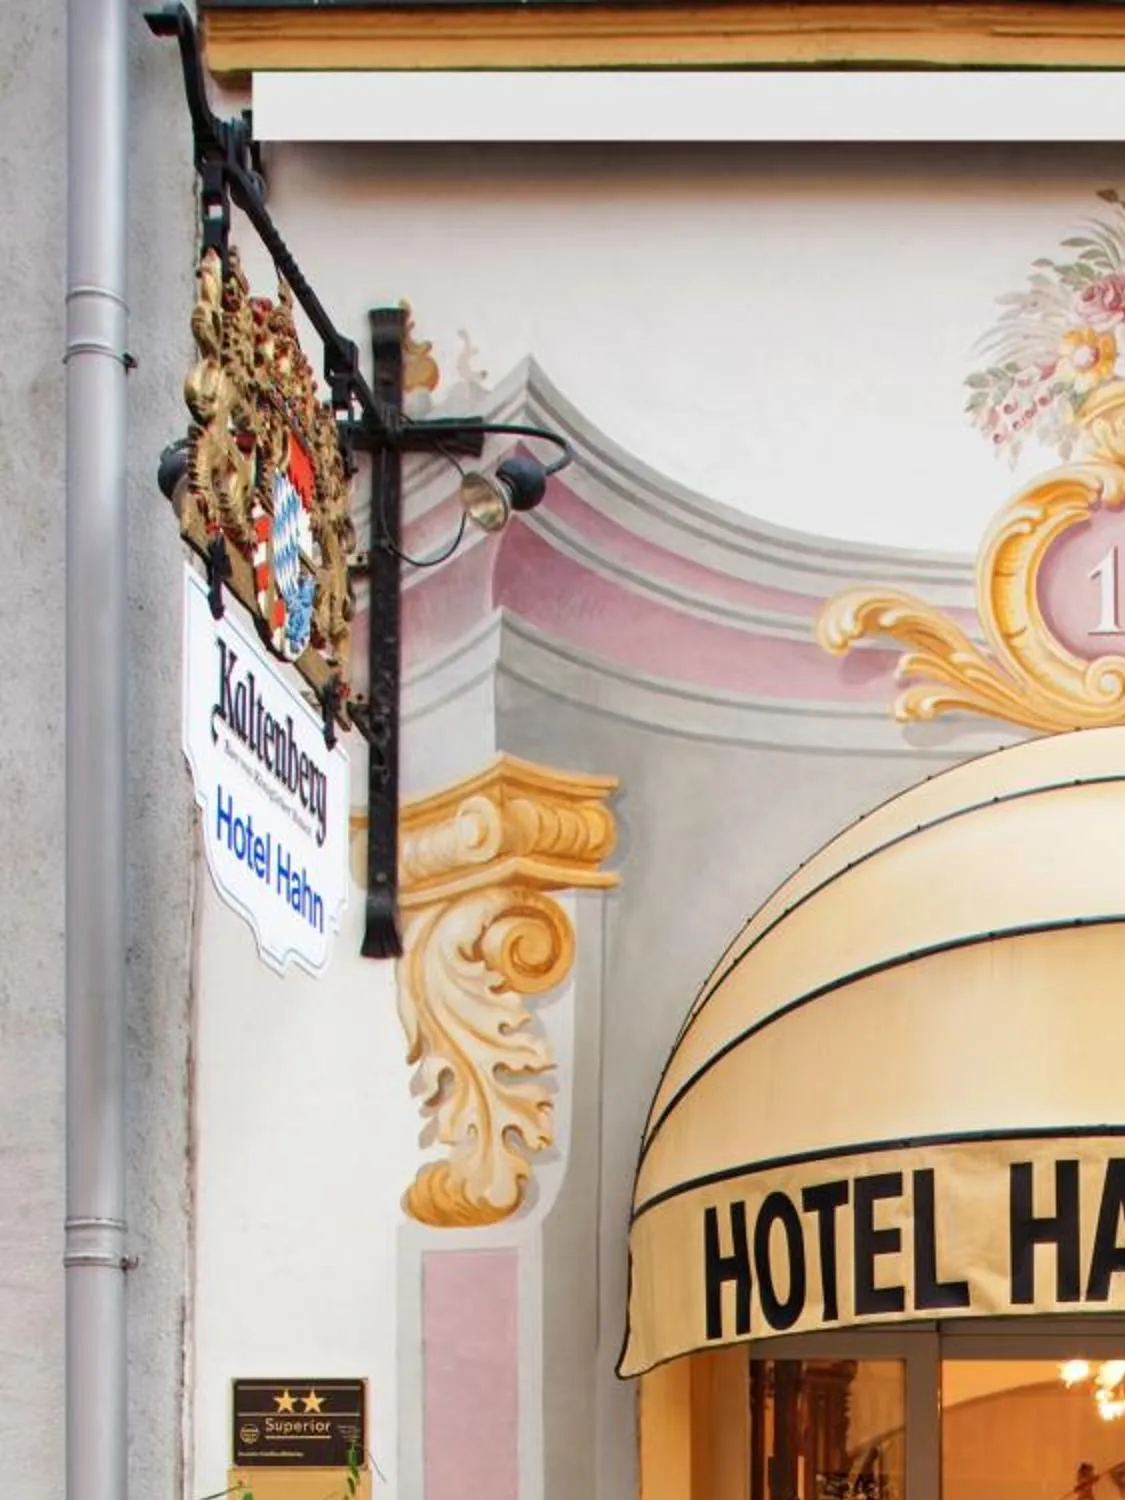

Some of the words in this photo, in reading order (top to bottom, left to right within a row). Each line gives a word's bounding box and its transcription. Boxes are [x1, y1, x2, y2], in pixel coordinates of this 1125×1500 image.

[211, 635, 327, 849] Kaltenberg
[216, 783, 271, 885] Hotel
[276, 841, 325, 934] Hahn
[703, 1168, 971, 1340] HOTEL
[264, 1417, 332, 1434] Superior
